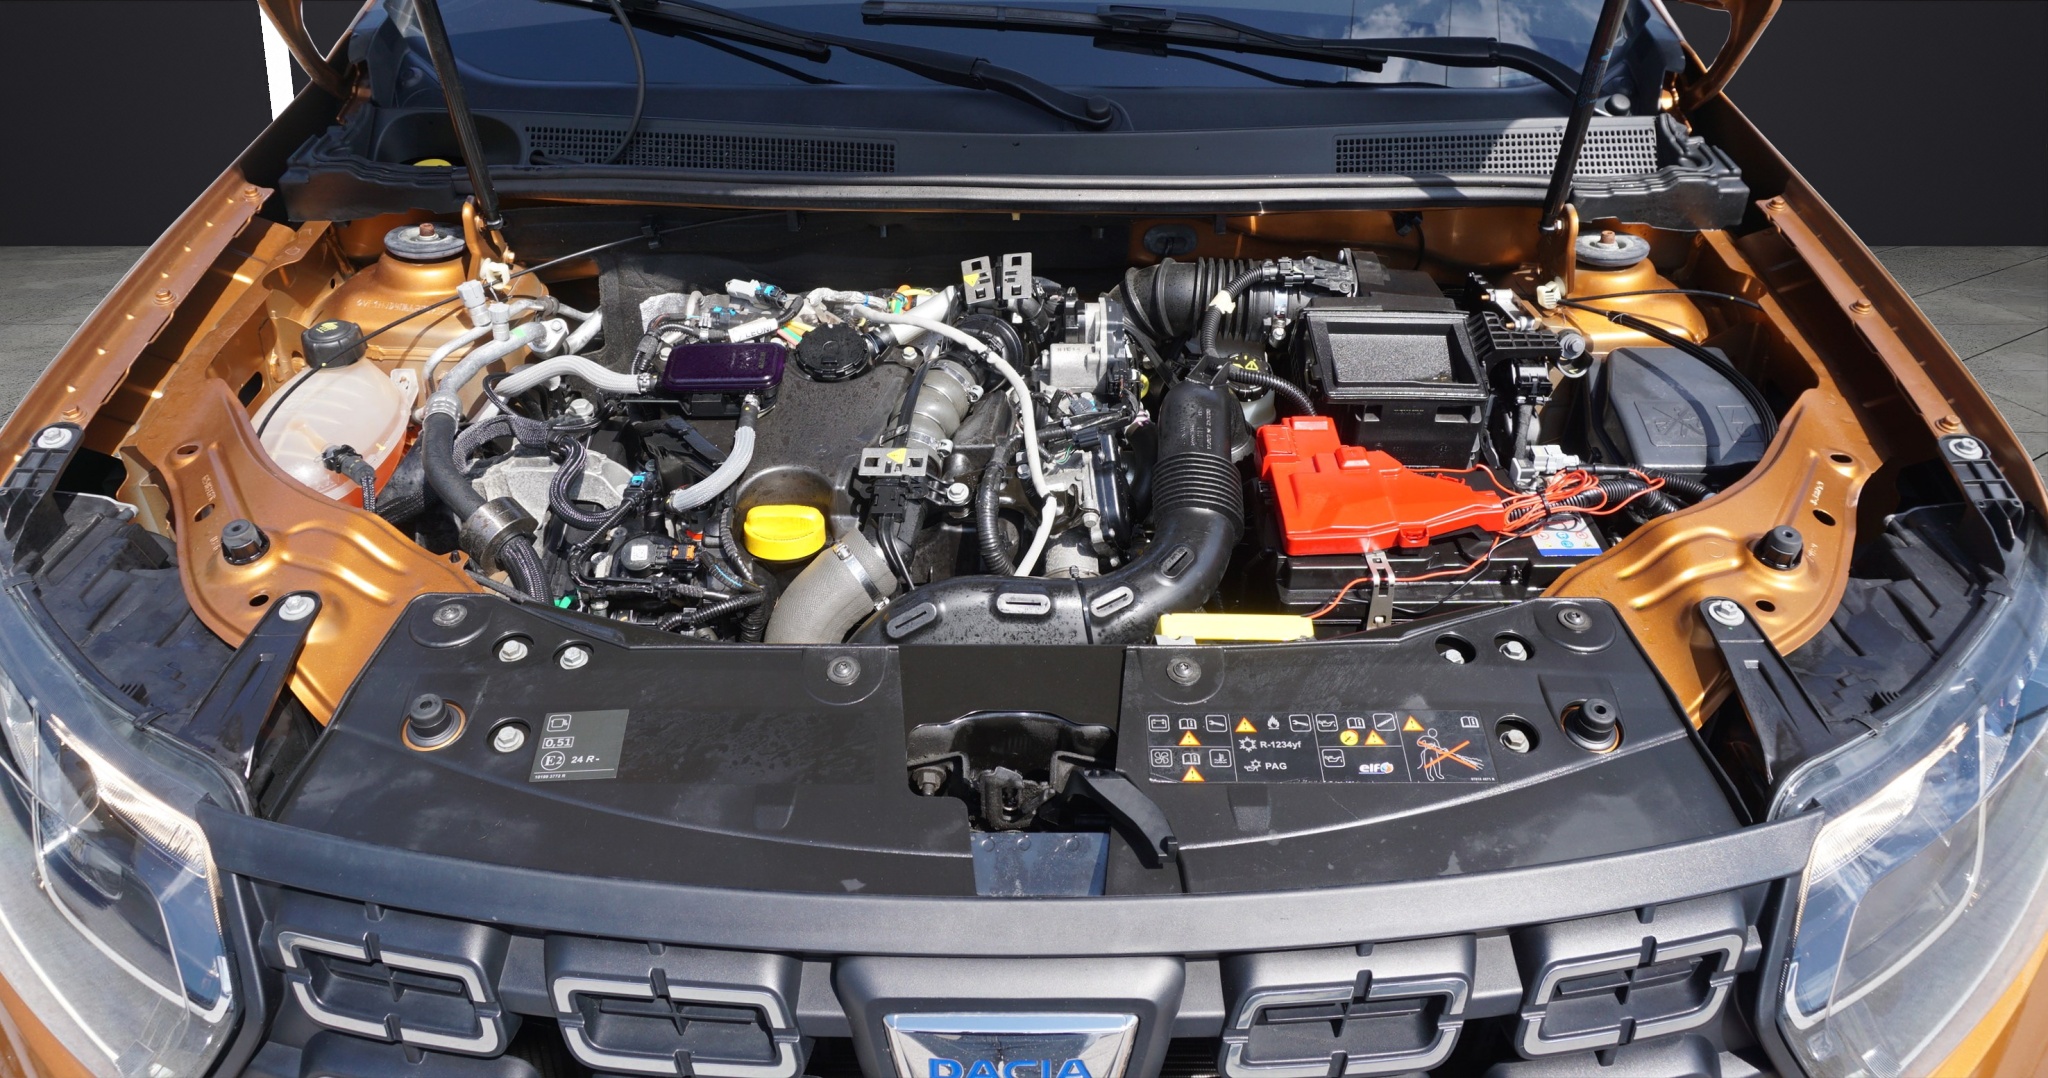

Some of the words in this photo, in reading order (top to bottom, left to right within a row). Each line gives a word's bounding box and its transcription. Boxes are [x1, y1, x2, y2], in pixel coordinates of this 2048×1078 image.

[745, 326, 772, 338] LEONI
[545, 738, 571, 748] 0,51
[1259, 741, 1302, 750] R-1234yf
[544, 755, 563, 767] E2
[570, 755, 583, 764] 24
[1265, 762, 1288, 770] PAG
[1358, 763, 1381, 773] elf
[928, 1058, 1093, 1078] DACIA
